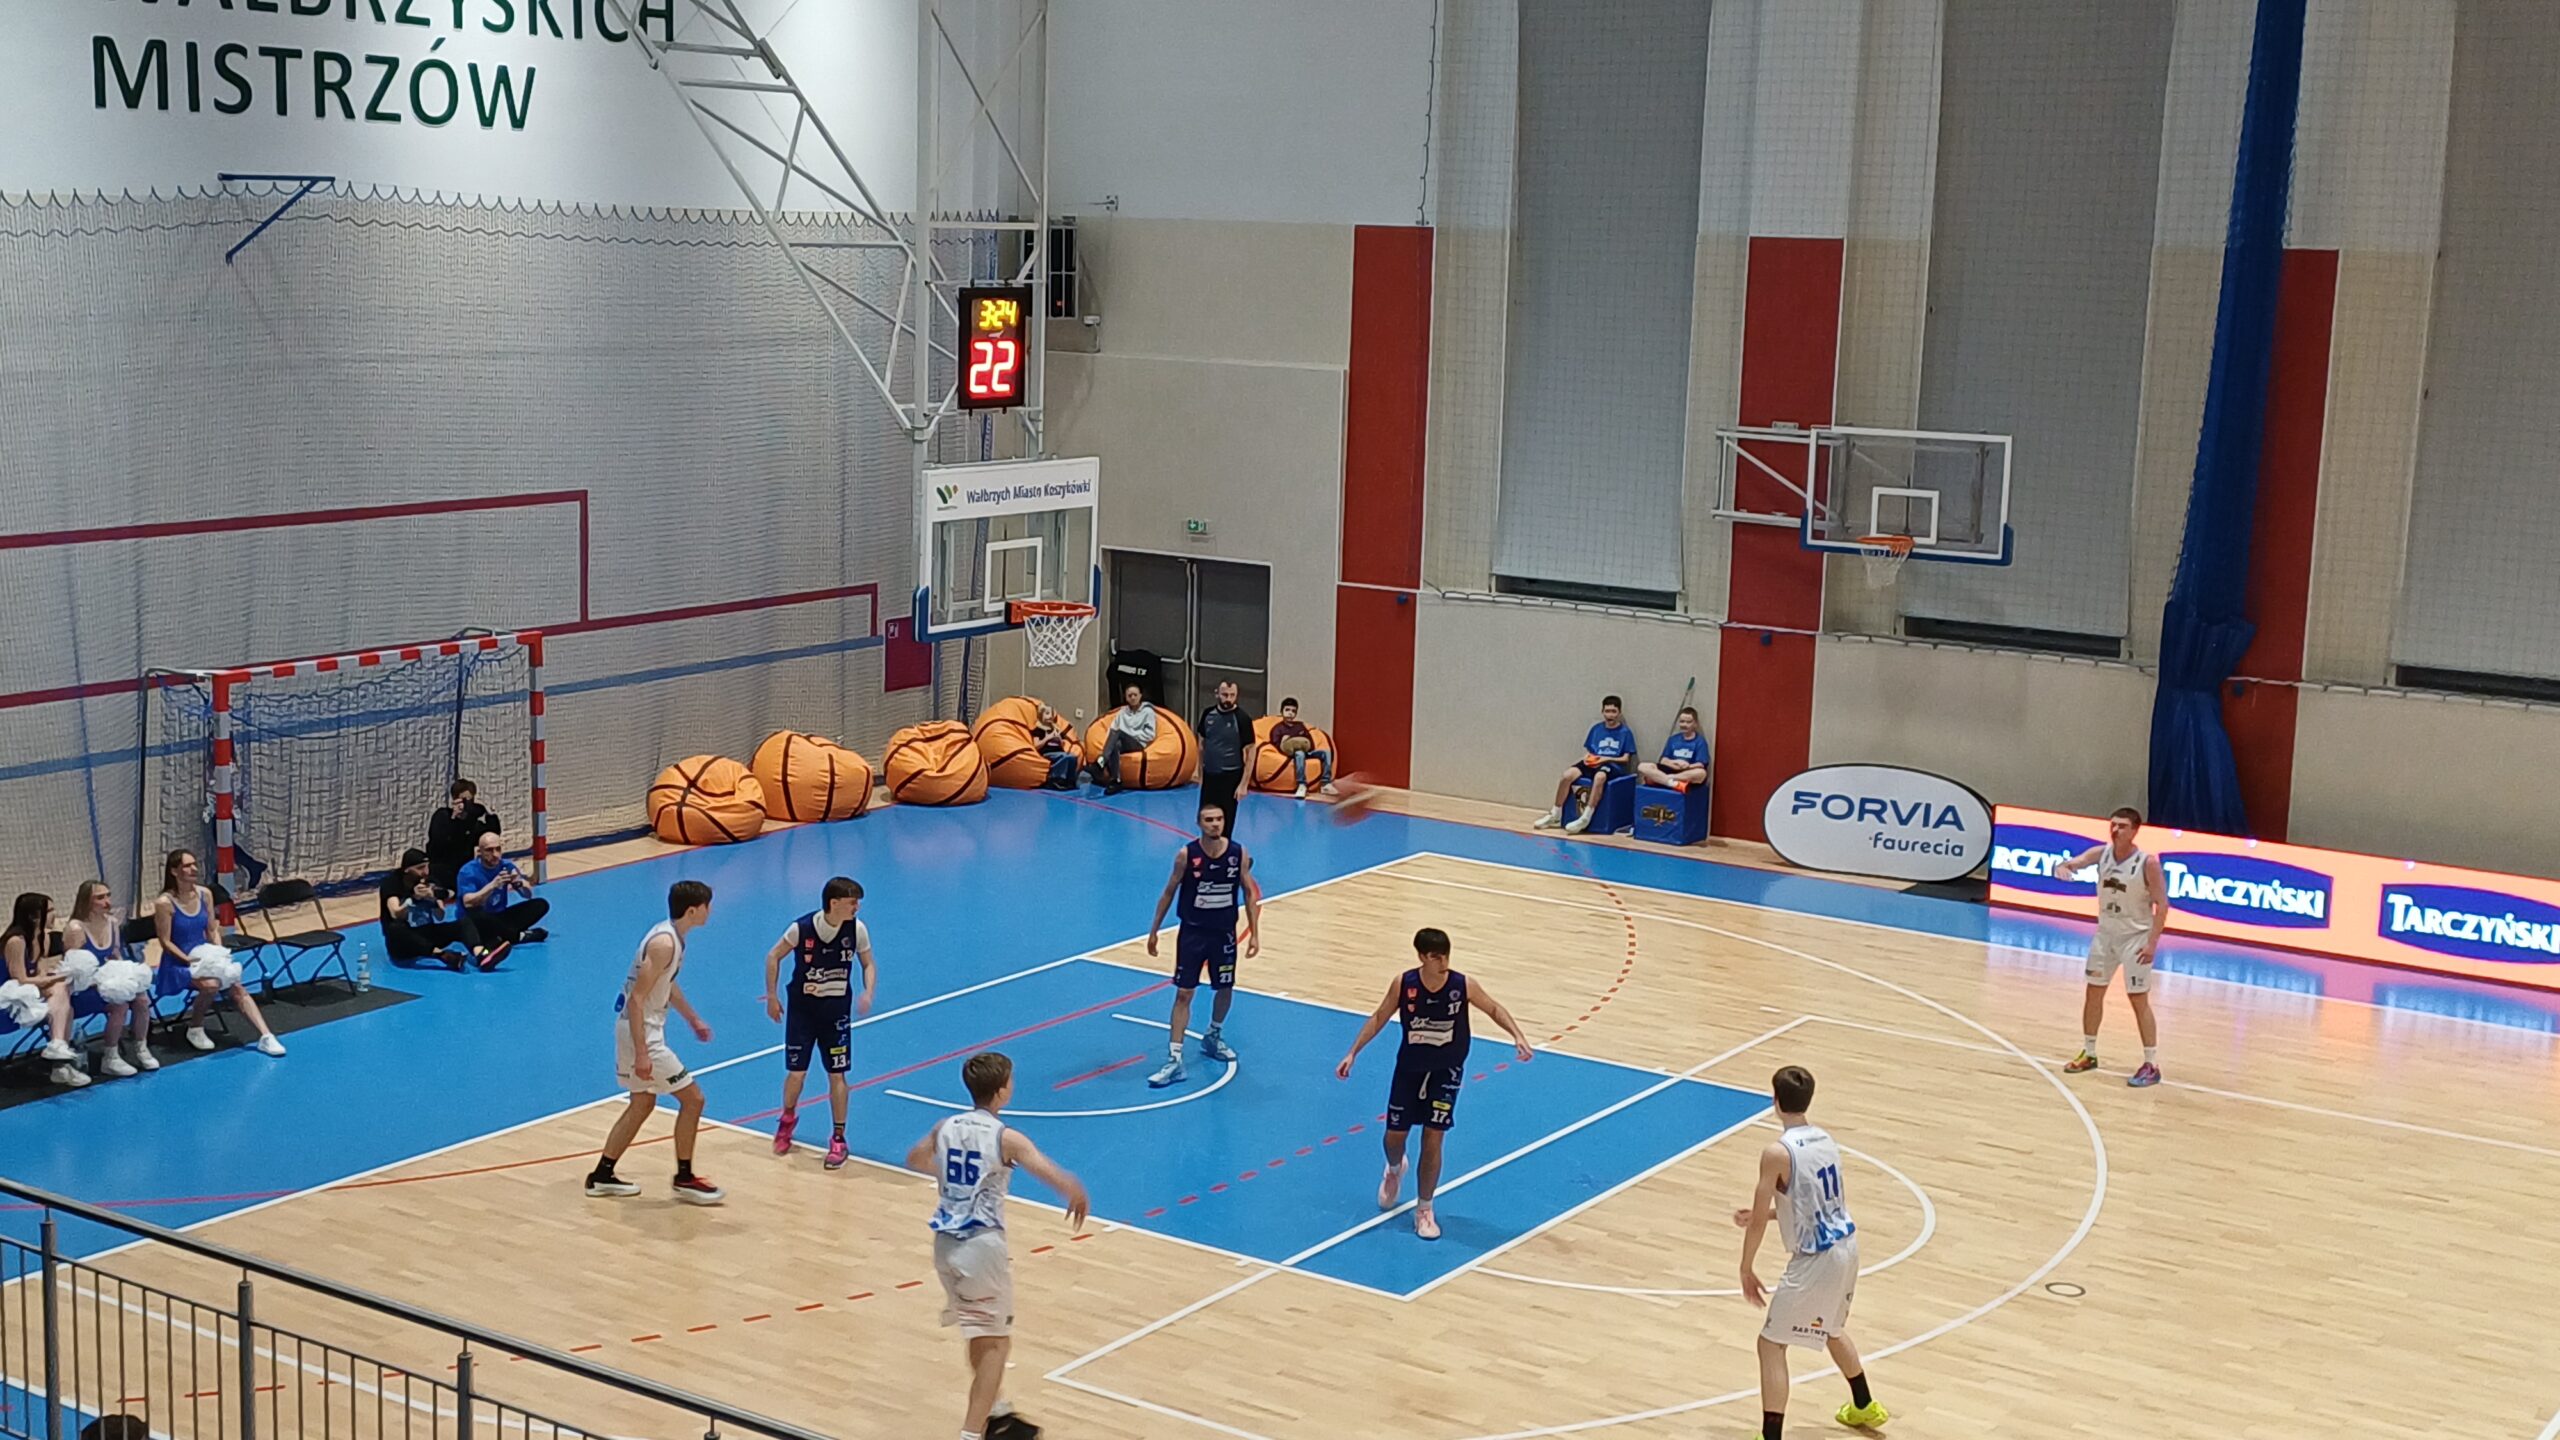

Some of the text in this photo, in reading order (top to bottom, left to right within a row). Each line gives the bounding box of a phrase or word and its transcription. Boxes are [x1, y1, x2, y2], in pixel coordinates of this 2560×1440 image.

[92, 34, 536, 131] MISTRZÓW
[969, 341, 1016, 394] 22
[966, 479, 1092, 506] Wałbrzych Miasto Koszykówki
[1791, 790, 1965, 832] FORVIA
[1872, 831, 1964, 857] faurecia
[2162, 861, 2325, 919] TARCZYŃSKI
[1448, 1001, 1463, 1016] 17
[831, 1054, 848, 1069] 13
[1430, 1109, 1448, 1124] 17
[1816, 1163, 1840, 1202] 11
